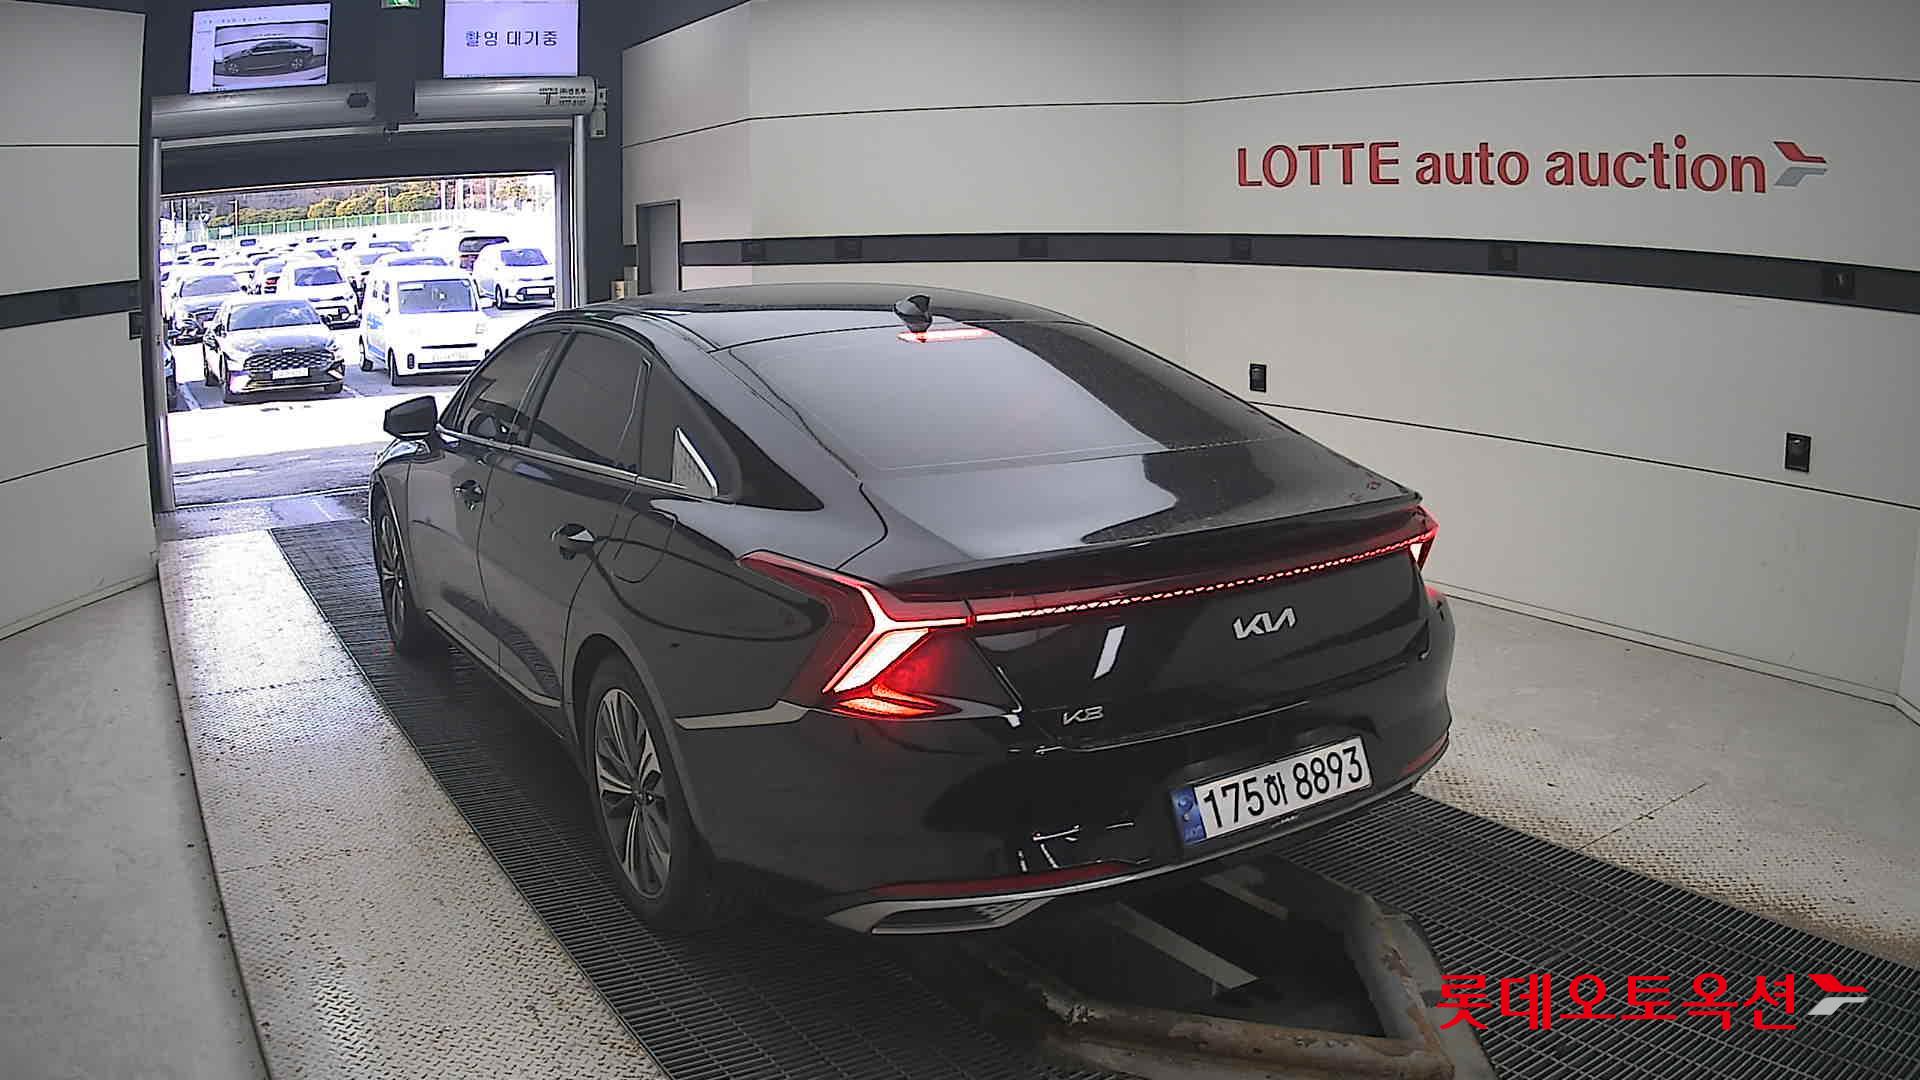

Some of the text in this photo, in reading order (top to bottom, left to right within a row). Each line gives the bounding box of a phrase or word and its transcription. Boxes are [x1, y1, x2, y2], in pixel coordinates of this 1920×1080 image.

[506, 30, 558, 47] 대기중
[1237, 134, 1767, 194] LOTTE auto auction
[1232, 607, 1297, 640] KIA
[1062, 704, 1105, 726] K8
[1203, 745, 1363, 829] 175하 8893
